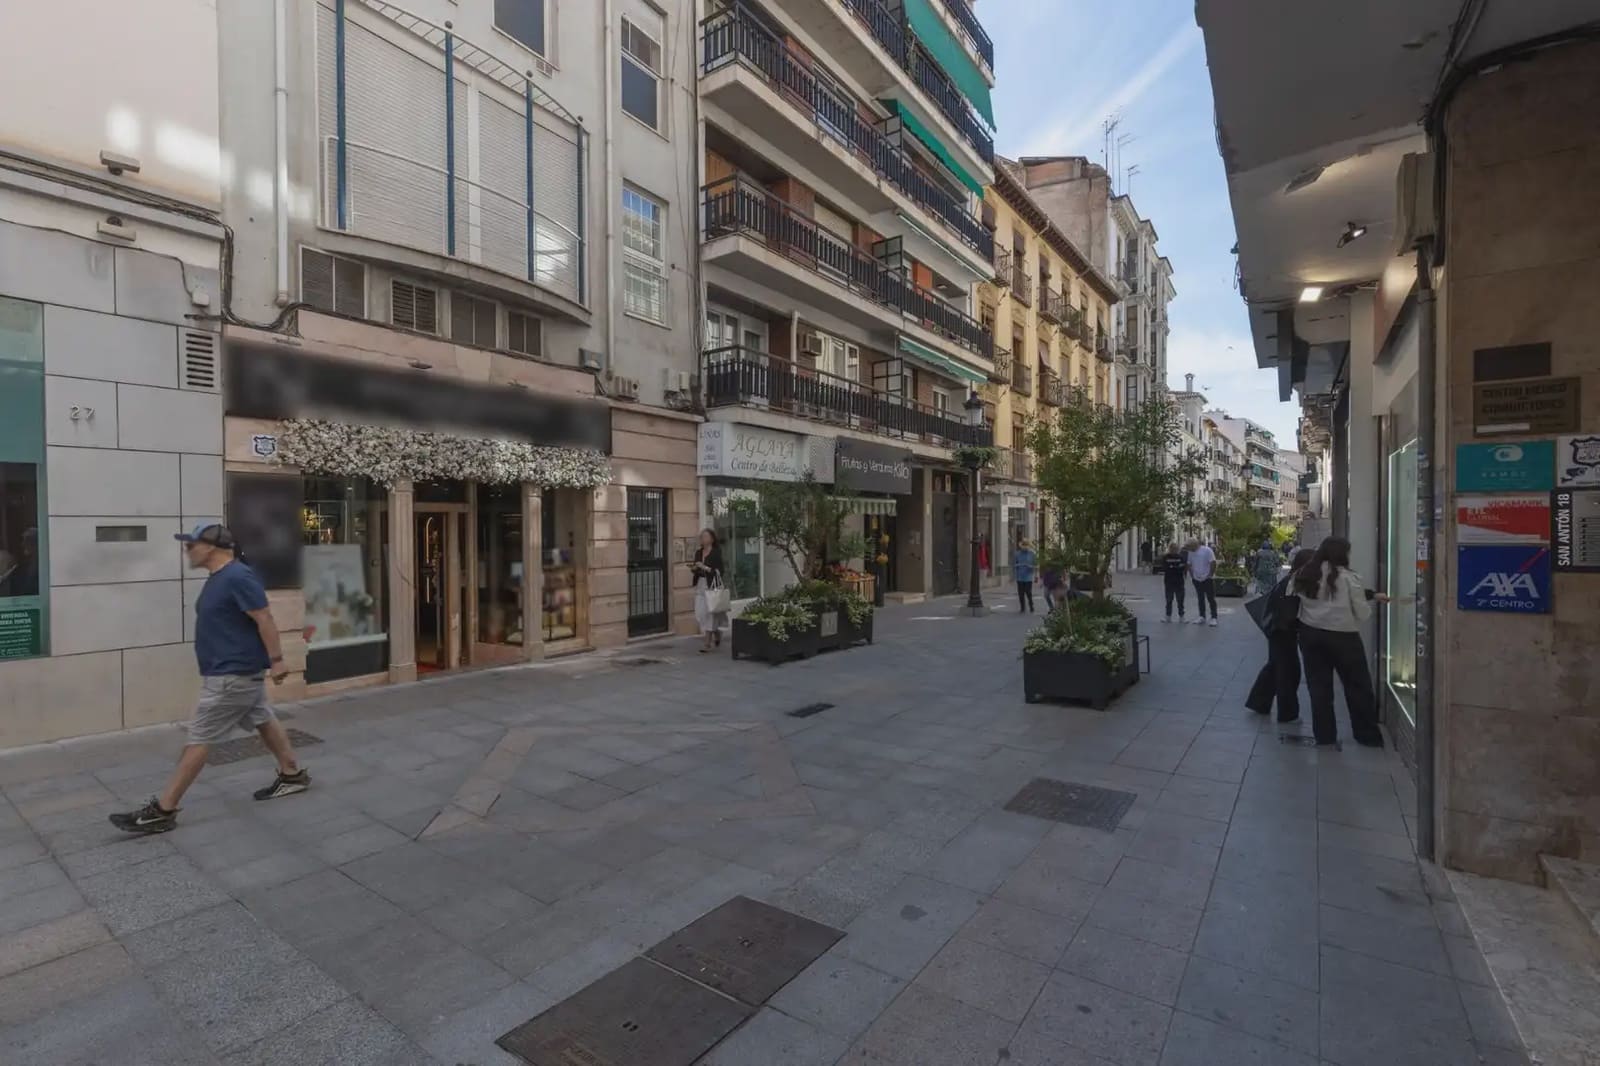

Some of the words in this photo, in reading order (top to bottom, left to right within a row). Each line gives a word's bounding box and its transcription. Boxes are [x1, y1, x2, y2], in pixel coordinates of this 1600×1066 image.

[71, 405, 96, 419] 27
[731, 431, 794, 458] AGLAYA
[731, 456, 757, 471] Centro
[759, 459, 768, 472] de
[1557, 493, 1570, 507] 18
[1555, 509, 1570, 541] ANTÓN
[1557, 545, 1570, 566] SAN
[1466, 572, 1541, 599] AXA
[1489, 599, 1536, 609] CENTRO
